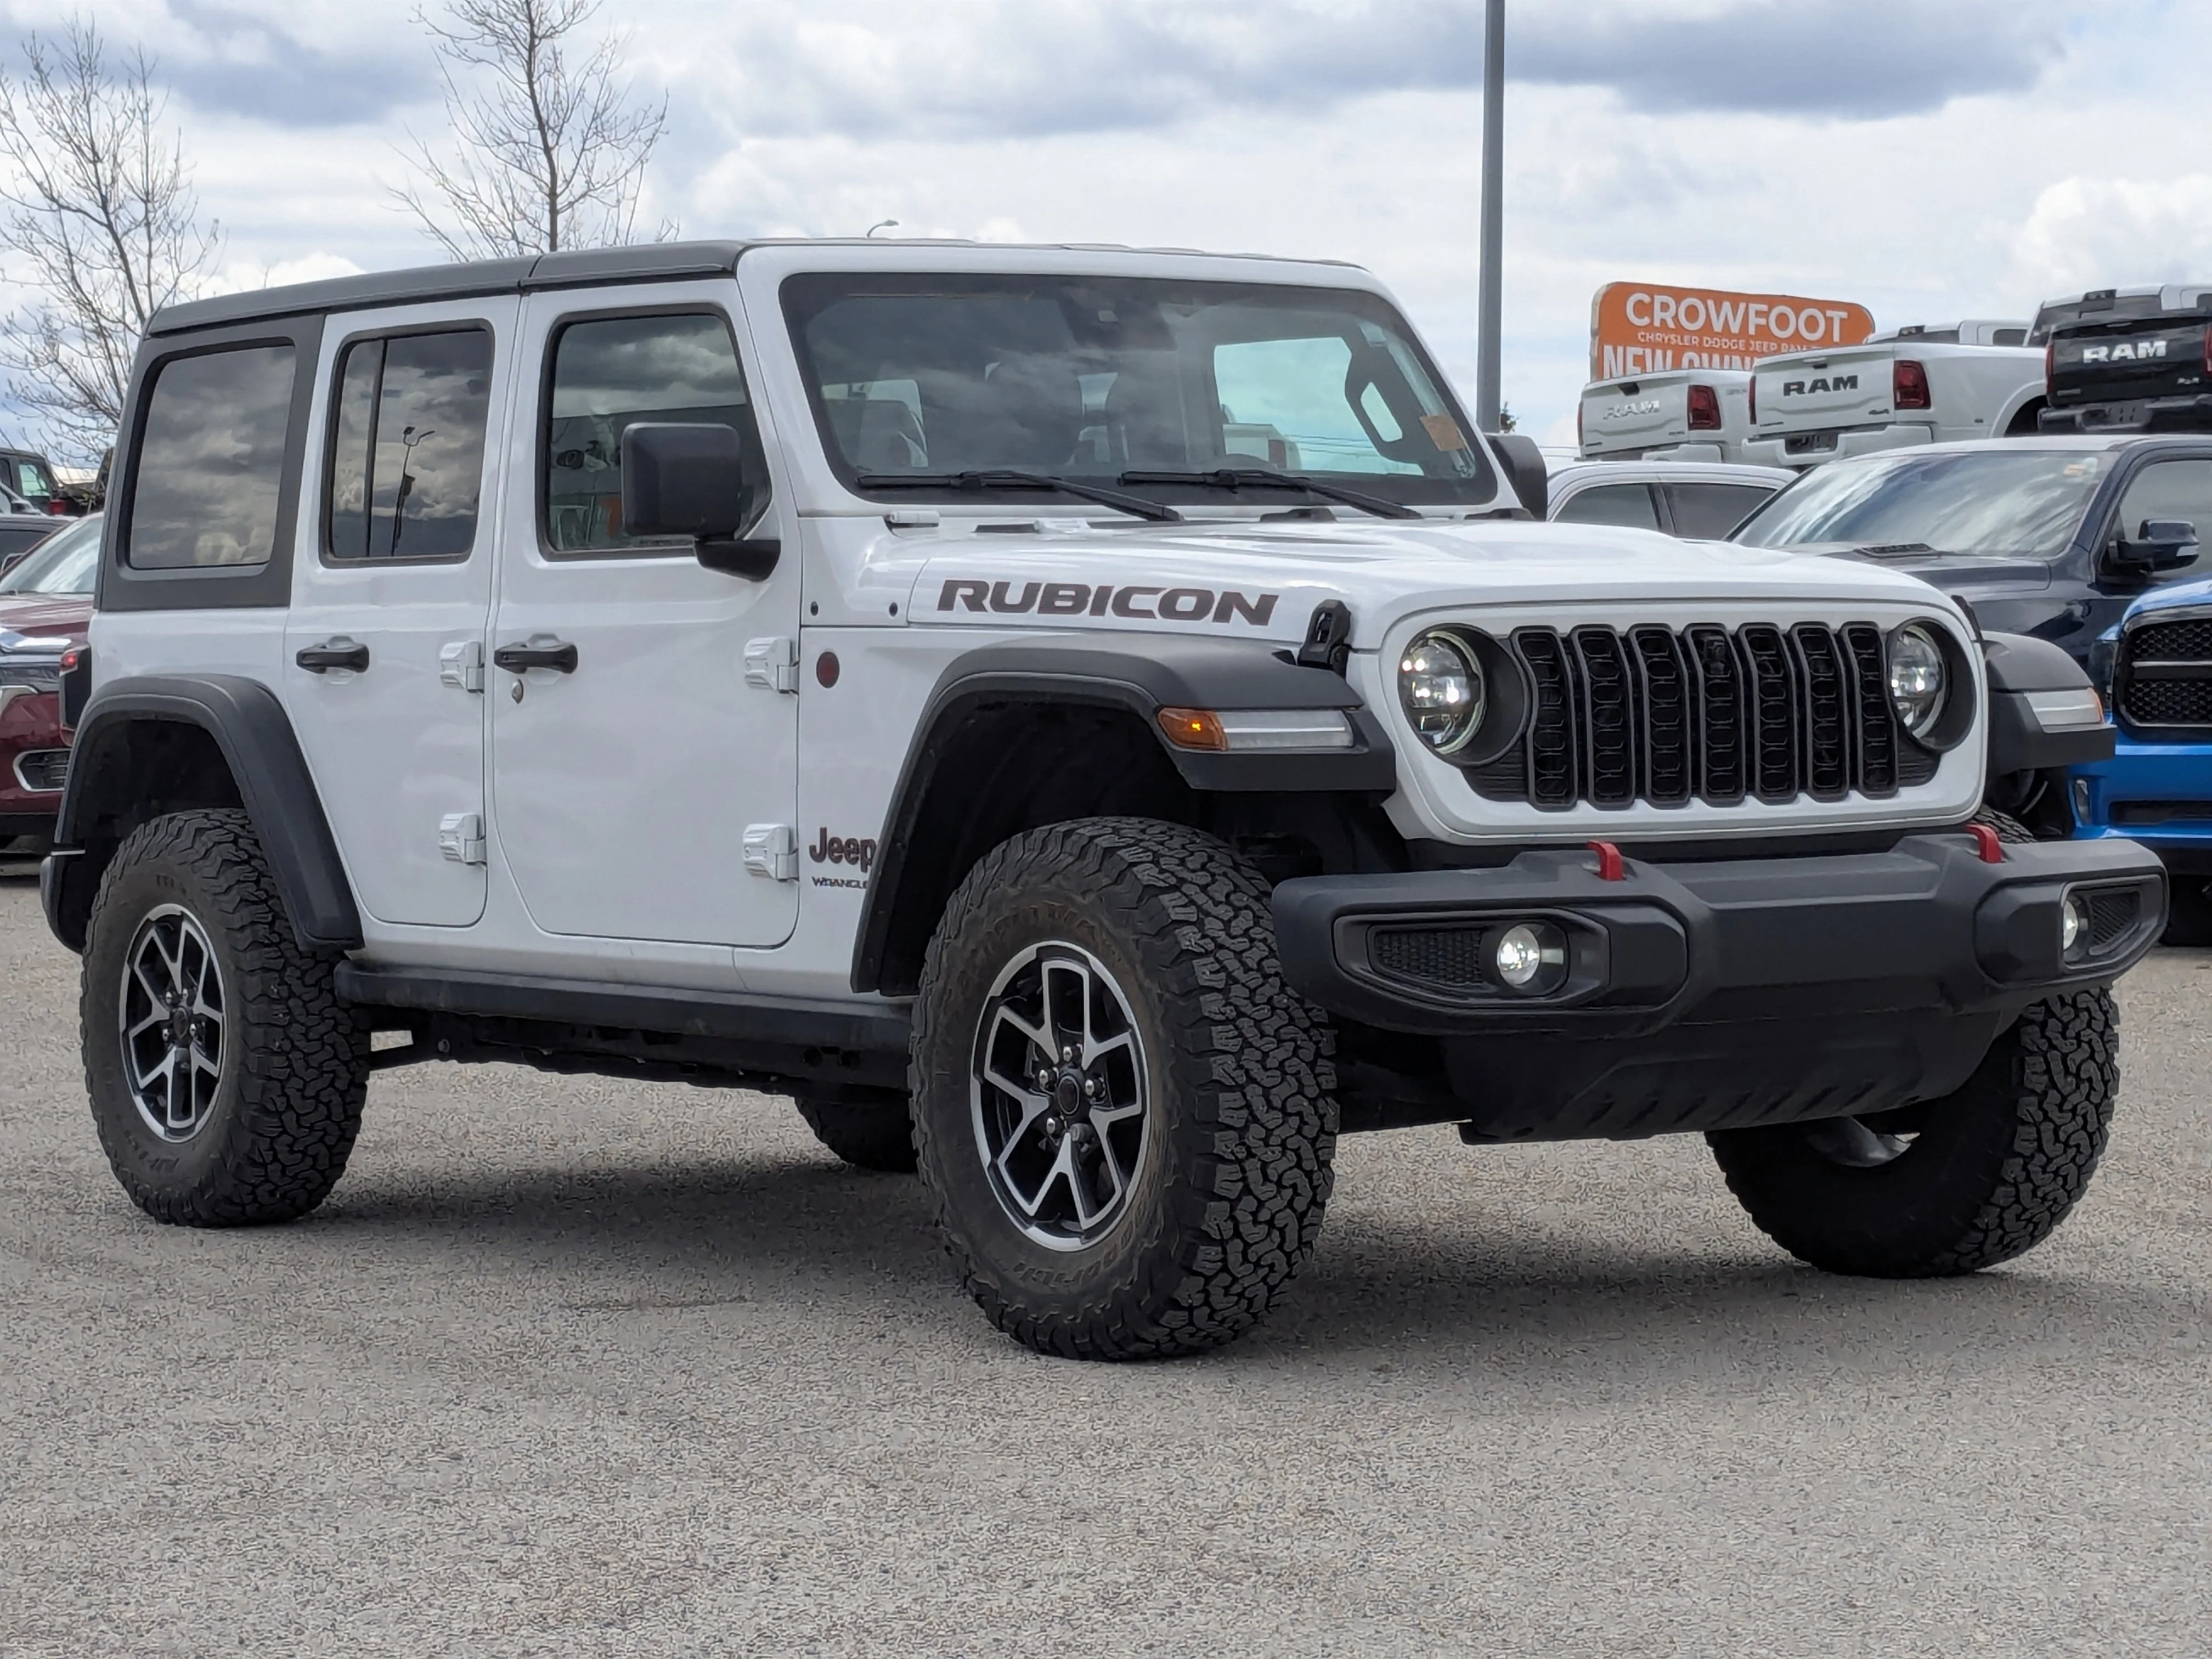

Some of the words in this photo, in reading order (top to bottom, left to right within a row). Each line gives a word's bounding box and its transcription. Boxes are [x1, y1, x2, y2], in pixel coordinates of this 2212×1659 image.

[1626, 292, 1848, 343] CROWFOOT
[1637, 331, 1699, 347] CHRYSLER
[1703, 336, 1746, 351] DODGE
[1749, 340, 1778, 353] JEEP
[2083, 340, 2167, 364] RAM
[1783, 375, 1858, 397] RAM
[1602, 399, 1660, 420] RAM
[936, 579, 1279, 627] RUBICON
[809, 827, 877, 873] Jeep
